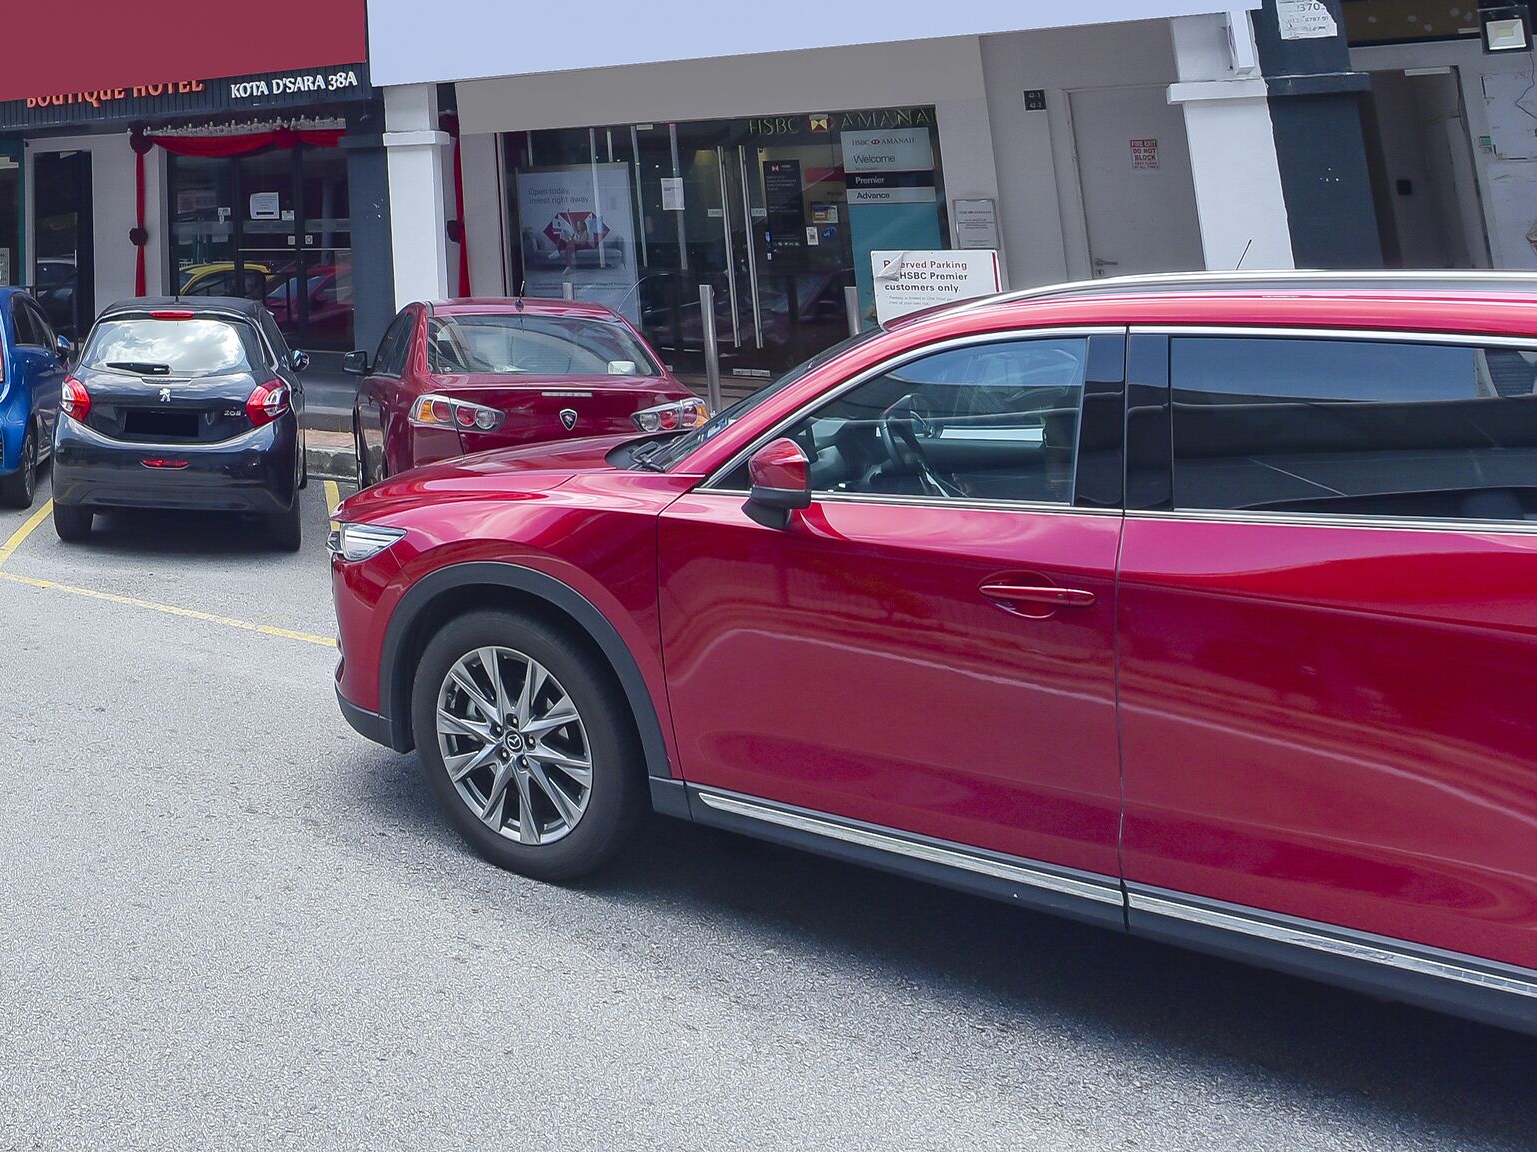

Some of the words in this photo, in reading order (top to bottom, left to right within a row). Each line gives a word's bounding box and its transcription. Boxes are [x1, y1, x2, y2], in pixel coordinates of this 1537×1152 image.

[231, 81, 268, 98] KOTA
[272, 76, 325, 93] D'SARA
[328, 71, 358, 90] 38A
[749, 117, 800, 136] HSBC
[841, 107, 934, 129] AMANA
[881, 137, 915, 145] AMANAH
[853, 154, 896, 164] Welcome
[855, 175, 885, 185] Premier
[528, 187, 548, 197] Open
[856, 191, 891, 200] Advance
[883, 260, 926, 269] Rerved
[930, 260, 967, 271] Parking
[900, 272, 927, 280] HSBC
[930, 272, 968, 280] Premier
[938, 284, 961, 293] only.
